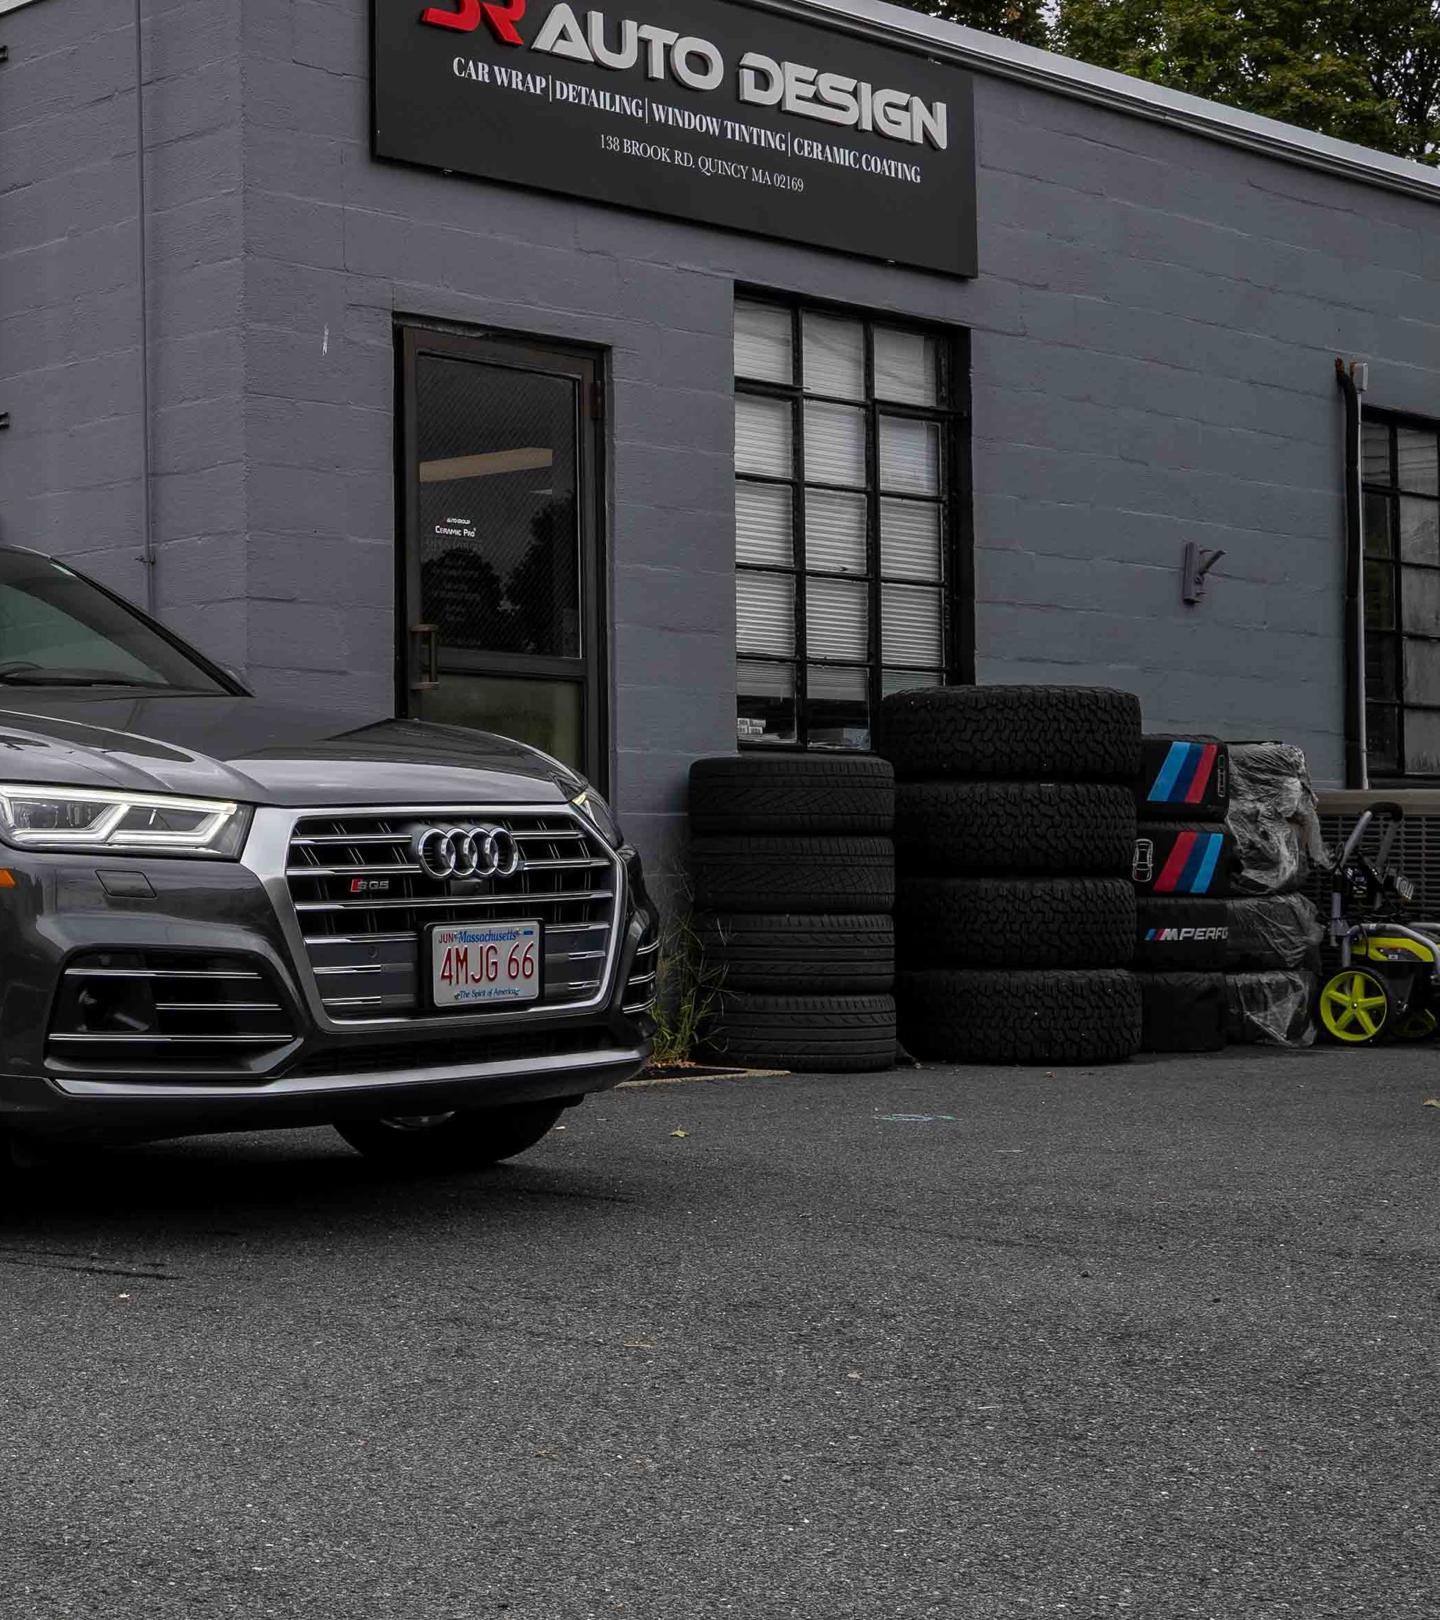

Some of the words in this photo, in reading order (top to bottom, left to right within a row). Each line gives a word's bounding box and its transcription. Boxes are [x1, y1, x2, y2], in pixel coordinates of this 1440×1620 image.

[531, 3, 724, 91] AUTO
[737, 51, 948, 150] DESIGN
[452, 56, 490, 84] CAR
[493, 65, 547, 95] WRAP
[555, 80, 644, 118] DETAILING
[652, 102, 722, 137] WINDOW
[724, 120, 785, 151] TINTING
[793, 137, 860, 169] CERAMIC
[861, 153, 921, 183] COATING
[600, 134, 620, 151] 138
[623, 138, 671, 163] BROOK
[674, 151, 696, 168] RD.
[698, 155, 748, 178] QUINCY
[751, 168, 771, 185] MA
[773, 172, 804, 192] 02169
[438, 933, 454, 944] JUN
[458, 930, 517, 944] Massachusetts
[441, 944, 499, 985] 4MJG
[507, 941, 535, 980] 66
[471, 989, 486, 998] Spirit
